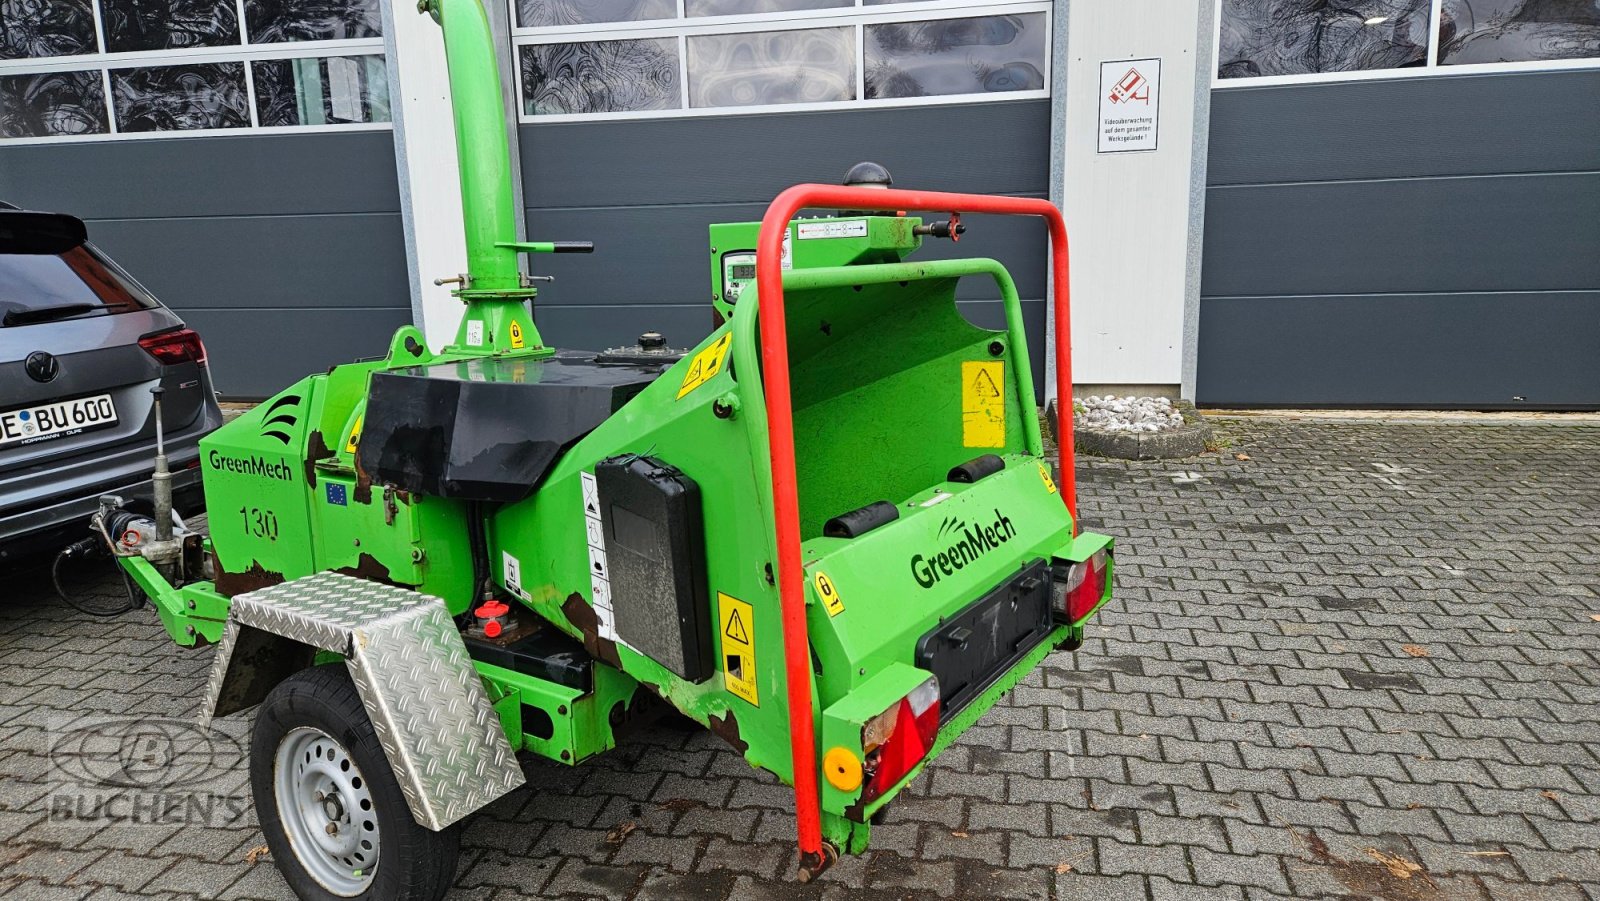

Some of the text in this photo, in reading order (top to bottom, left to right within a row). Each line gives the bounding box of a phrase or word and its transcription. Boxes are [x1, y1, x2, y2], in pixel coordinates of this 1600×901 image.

[0, 398, 113, 439] E BU 600
[21, 432, 60, 445] HOPPMANN
[209, 449, 293, 481] GreenMech
[240, 506, 279, 541] 130
[910, 508, 1017, 589] GreenMech
